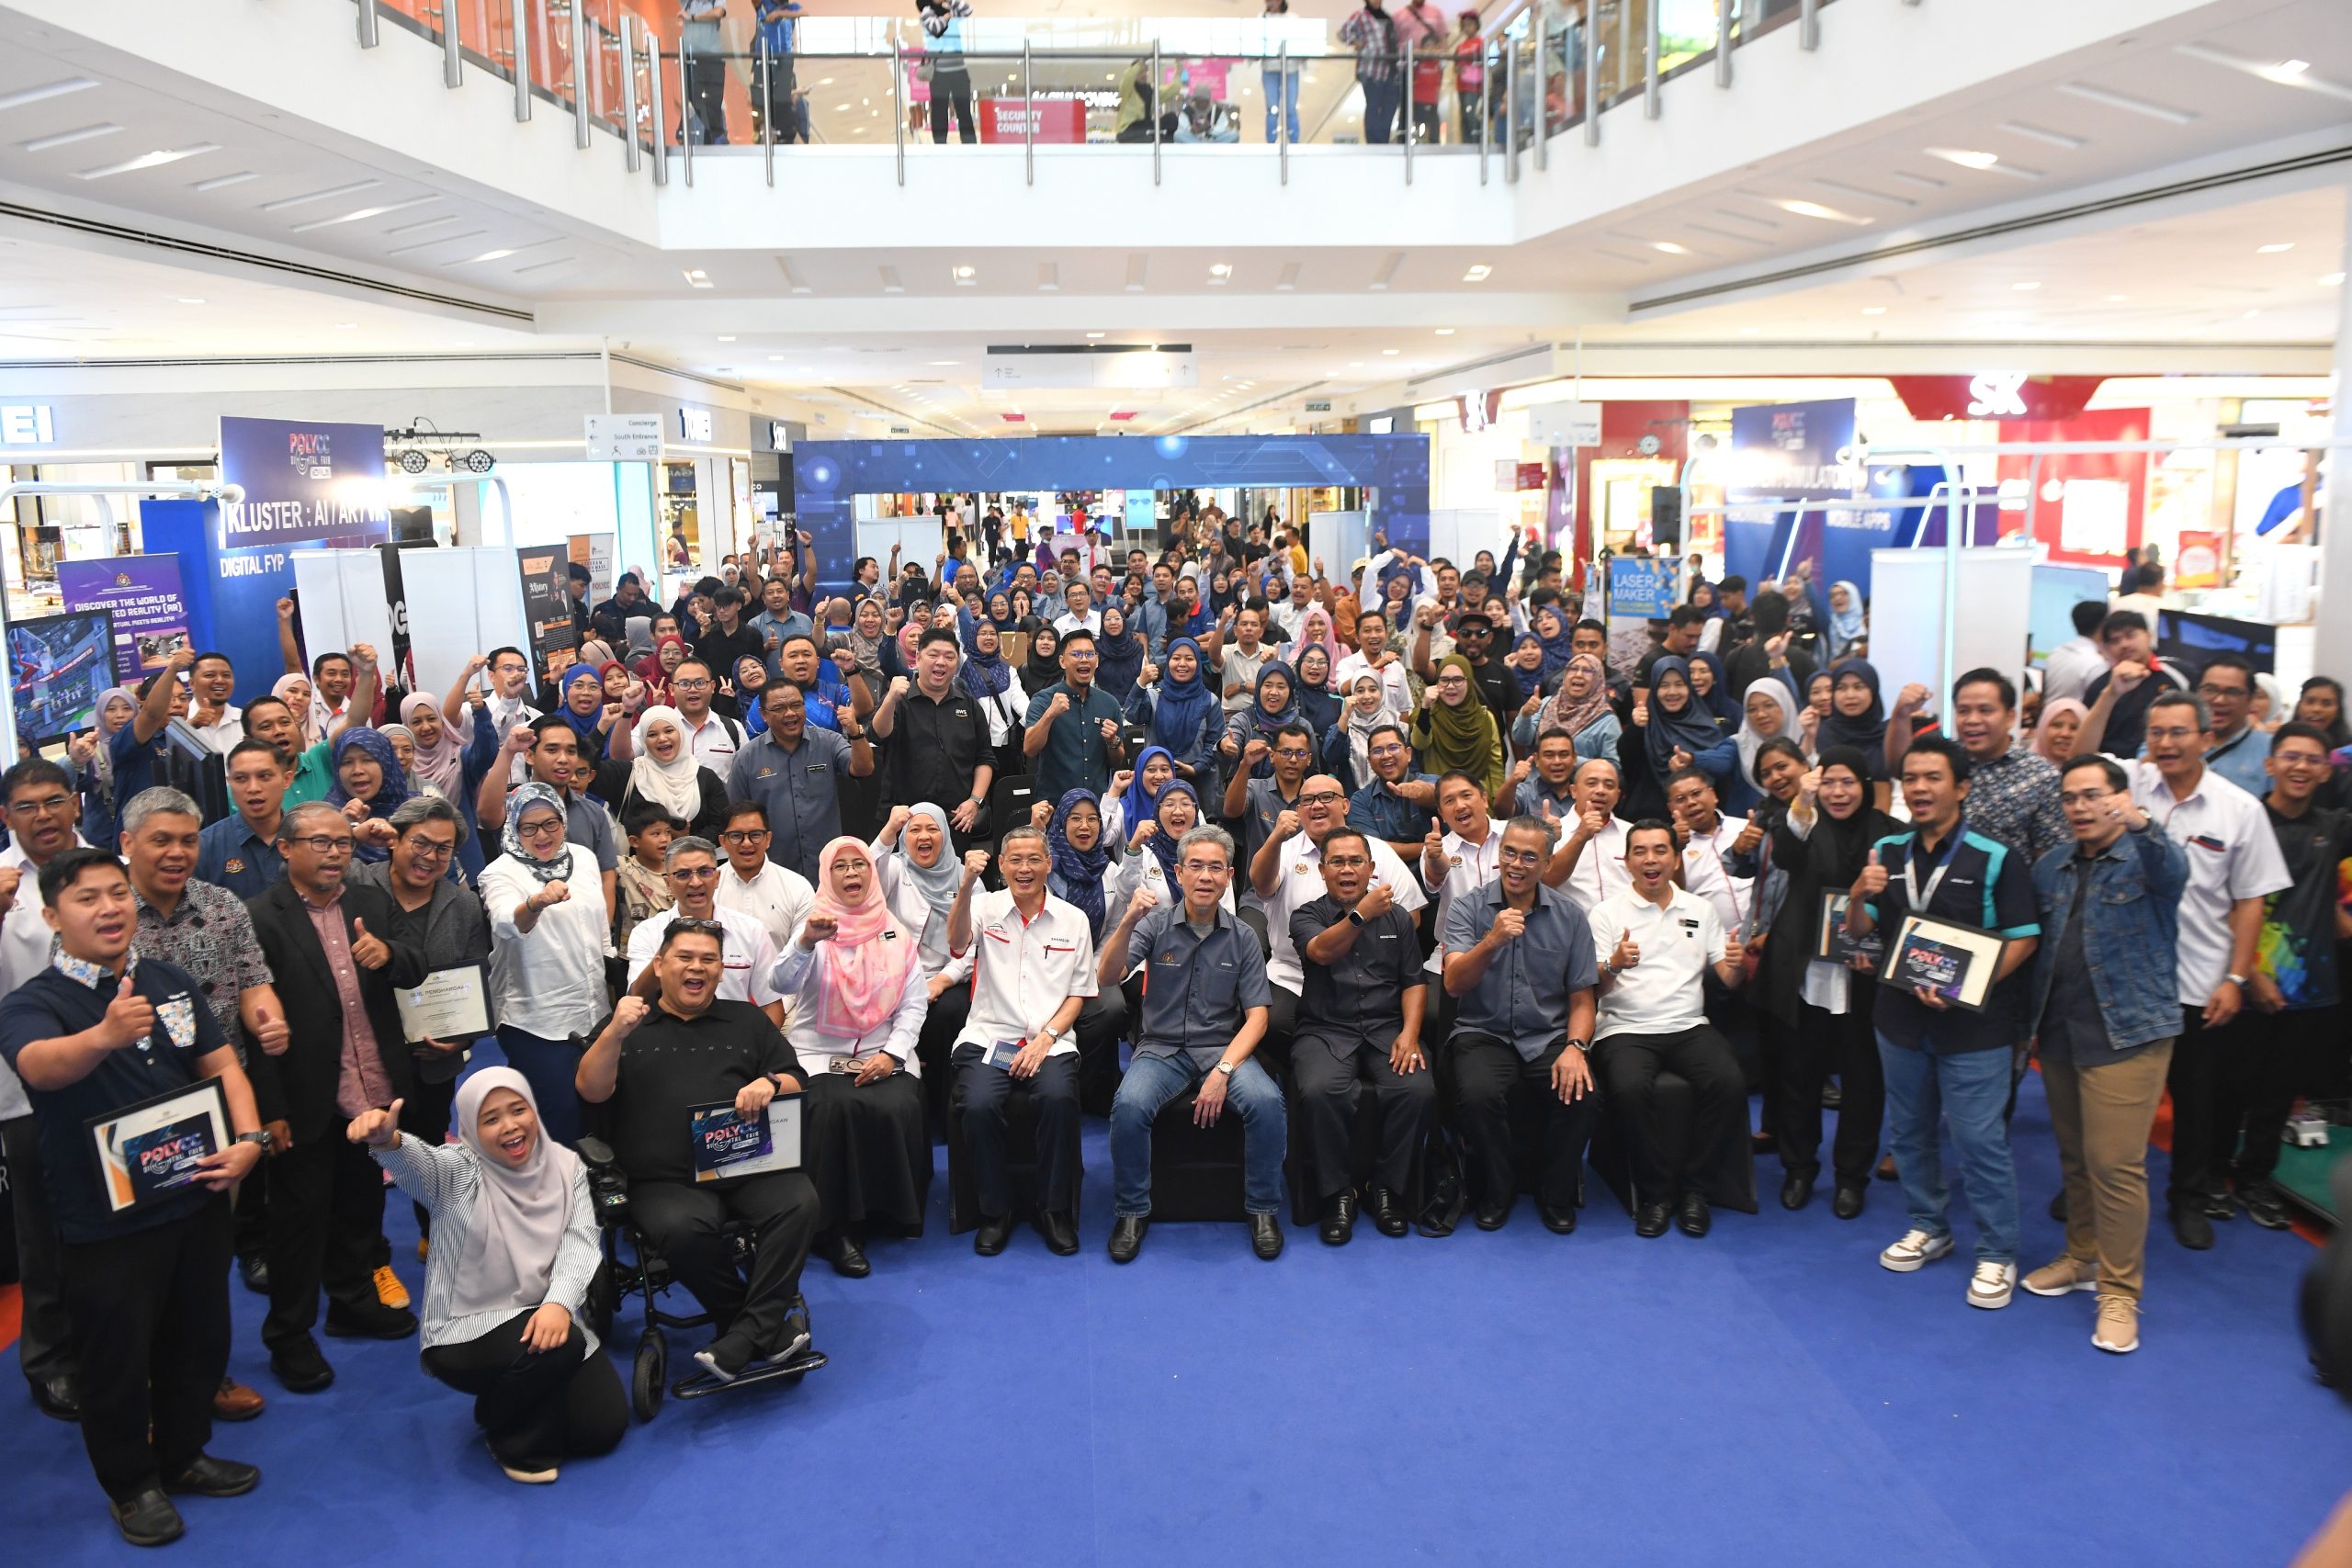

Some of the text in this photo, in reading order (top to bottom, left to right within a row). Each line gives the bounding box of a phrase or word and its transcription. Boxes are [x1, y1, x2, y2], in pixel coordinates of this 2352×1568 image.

[997, 110, 1043, 121] SECURTY
[228, 501, 303, 533] KLUSTER
[315, 500, 329, 526] AI
[220, 553, 285, 578] DIGITAL FYP
[1614, 573, 1655, 588] LASER
[1614, 588, 1656, 602] MAKER
[74, 594, 177, 612] DISCOVER THE WORLD OF
[128, 606, 162, 617] REALITY
[745, 1131, 760, 1140] FAIR
[140, 1132, 202, 1166] POLYCC
